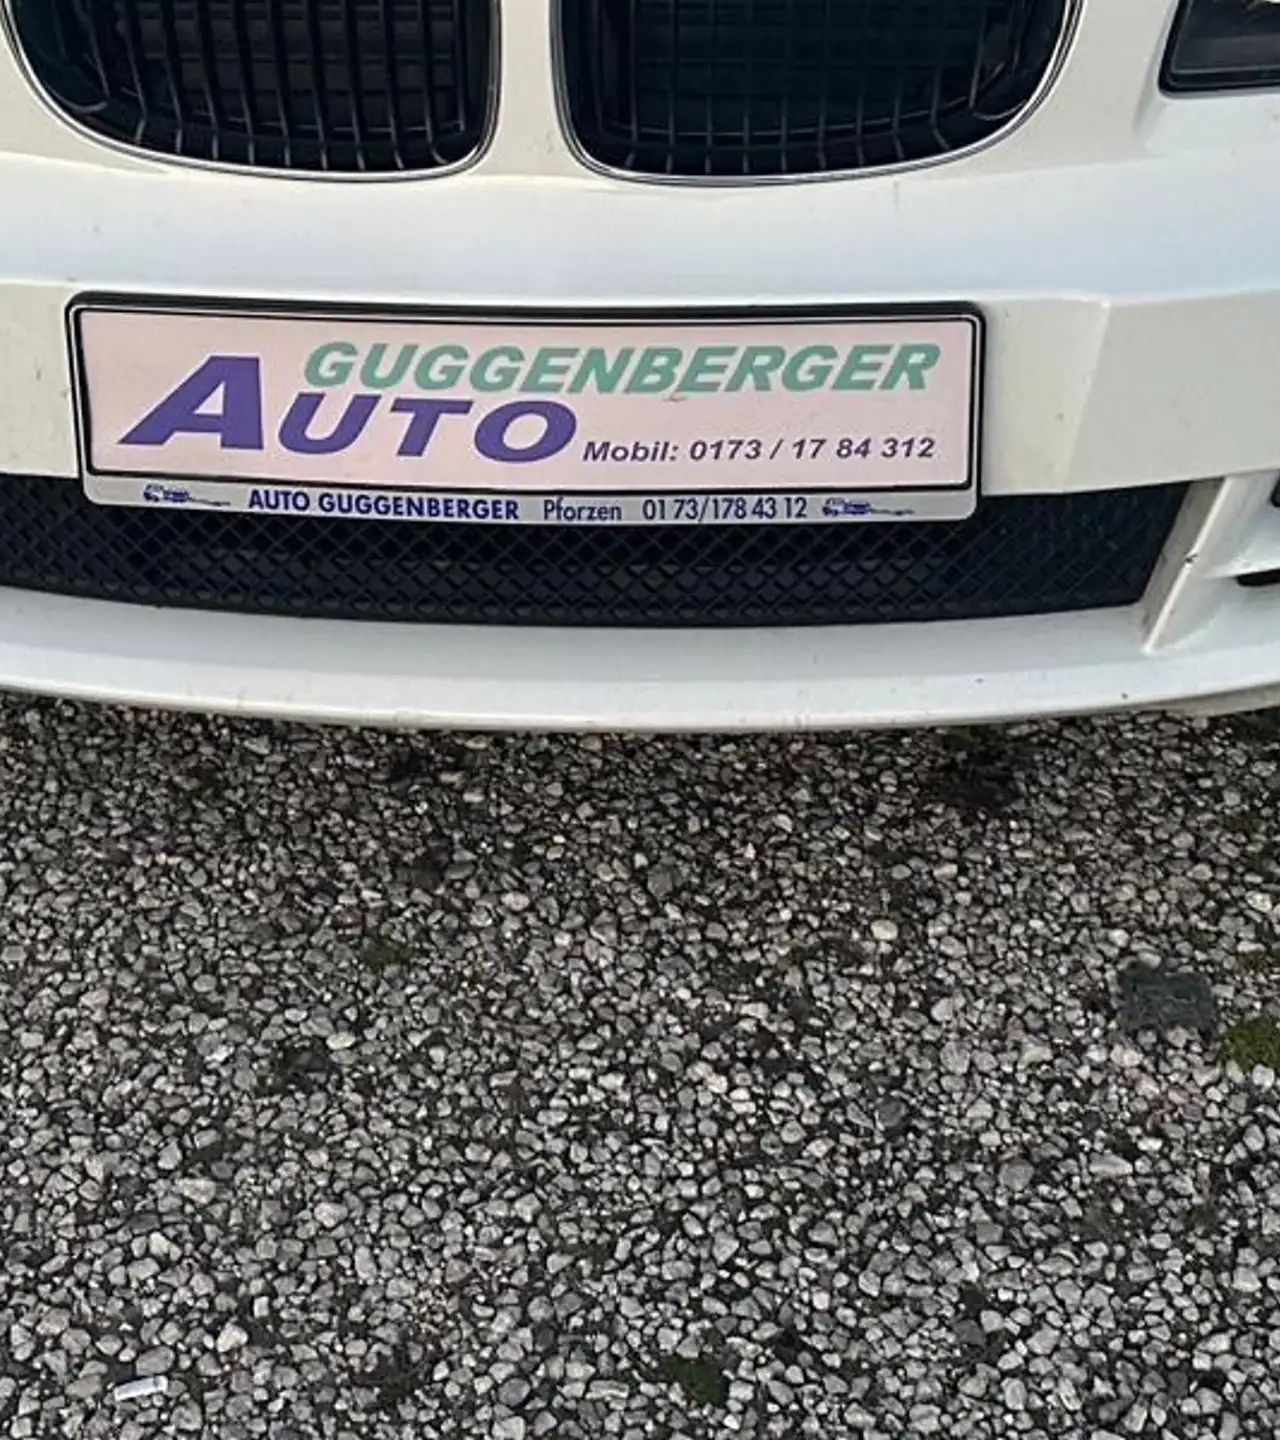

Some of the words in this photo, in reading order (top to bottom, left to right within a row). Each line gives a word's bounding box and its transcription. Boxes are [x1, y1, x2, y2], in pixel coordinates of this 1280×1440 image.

[303, 341, 942, 392] GUGGENBERGER
[118, 354, 578, 463] AUTO
[582, 441, 680, 462] Mobil:
[690, 440, 762, 461] 0173
[792, 438, 827, 459] 17
[836, 438, 871, 459] 84
[881, 437, 936, 458] 312
[248, 488, 311, 512] AUTO
[319, 491, 520, 521] GUGGENBERGER
[543, 497, 623, 522] Pforzen
